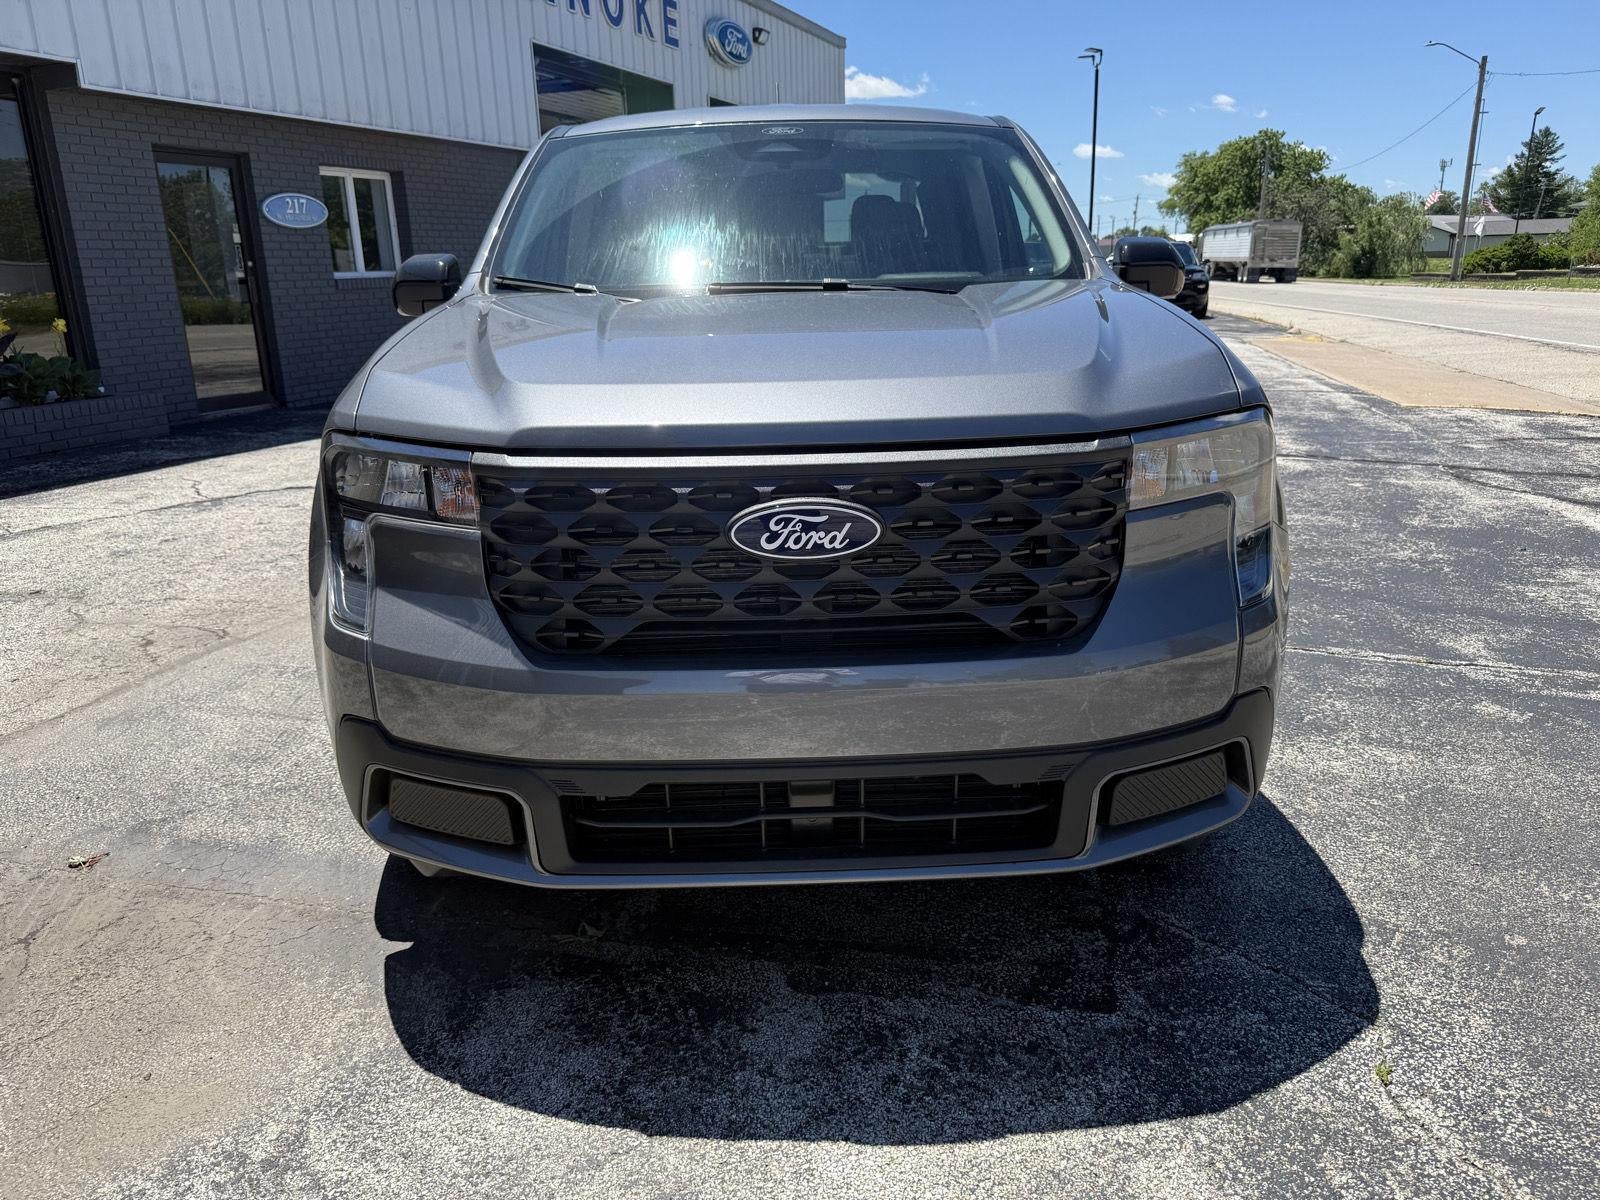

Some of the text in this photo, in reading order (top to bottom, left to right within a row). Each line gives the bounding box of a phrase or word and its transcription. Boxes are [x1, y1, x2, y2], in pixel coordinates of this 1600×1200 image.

[725, 28, 748, 58] Ford
[285, 198, 307, 214] 217
[760, 514, 851, 549] Ford
